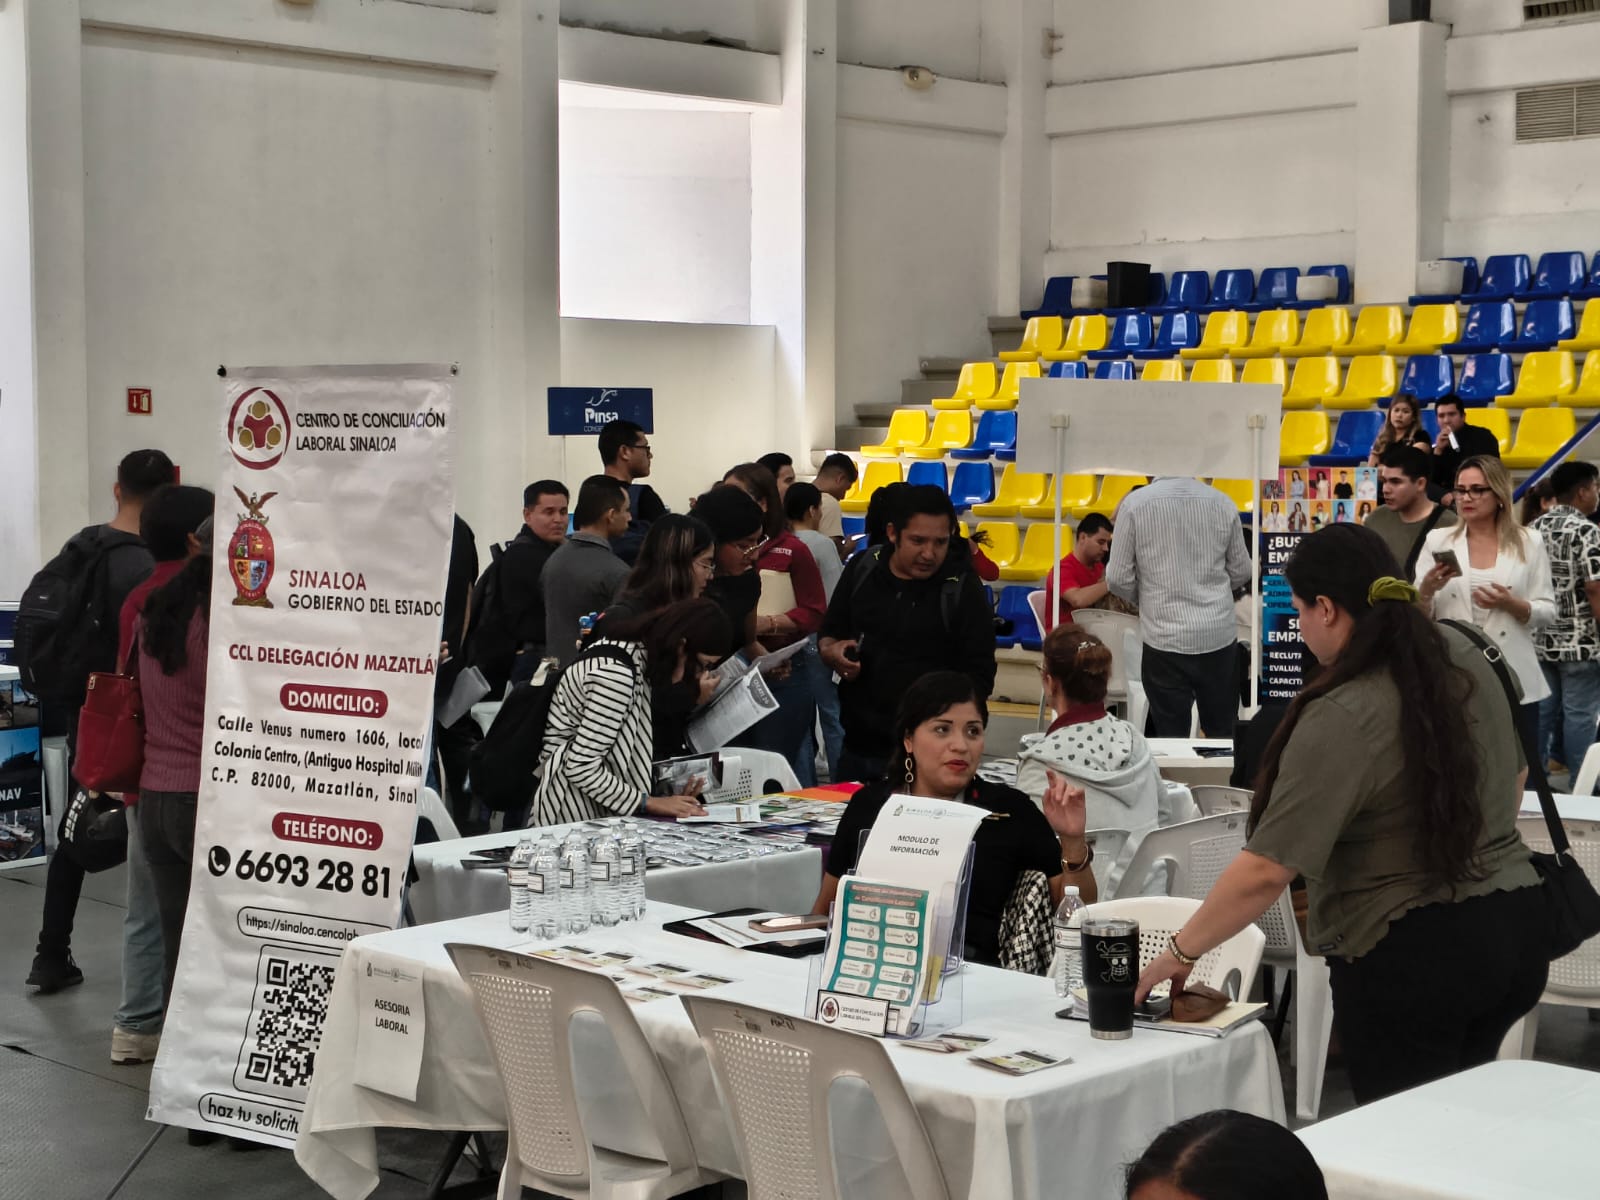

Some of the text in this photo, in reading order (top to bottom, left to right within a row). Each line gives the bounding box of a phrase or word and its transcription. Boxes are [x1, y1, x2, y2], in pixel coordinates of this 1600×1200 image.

[296, 408, 446, 429] CENTRO DE CONCILIACIÓN
[296, 436, 397, 452] LABORAL SINALOA
[289, 569, 367, 591] SINALOA
[288, 593, 443, 617] GOBIERNO DEL ESTADO
[229, 643, 437, 676] CCL DELEGACIÓN MAZATLÁ
[288, 690, 380, 714] DOMICILIO:
[217, 715, 254, 733] Calle
[261, 720, 293, 737] Venus
[300, 727, 346, 743] numero
[356, 728, 390, 749] 1606,
[214, 741, 262, 760] Colonia
[264, 747, 302, 767] Centro,
[304, 750, 352, 772] (Antiguo
[355, 756, 404, 777] Hospital
[211, 766, 418, 804] C.P. 82000, Mazatlán, Sinal
[282, 818, 374, 846] TELÉFONO:
[897, 834, 940, 846] MODULO DE
[889, 845, 940, 857] INFORMACIÓN
[235, 850, 309, 888] 6693
[316, 858, 354, 894] 28
[361, 864, 390, 899] 81
[374, 998, 411, 1018] ASESORIA
[375, 1016, 409, 1035] LABORAL
[208, 1097, 234, 1119] haz
[237, 1102, 251, 1122] tu
